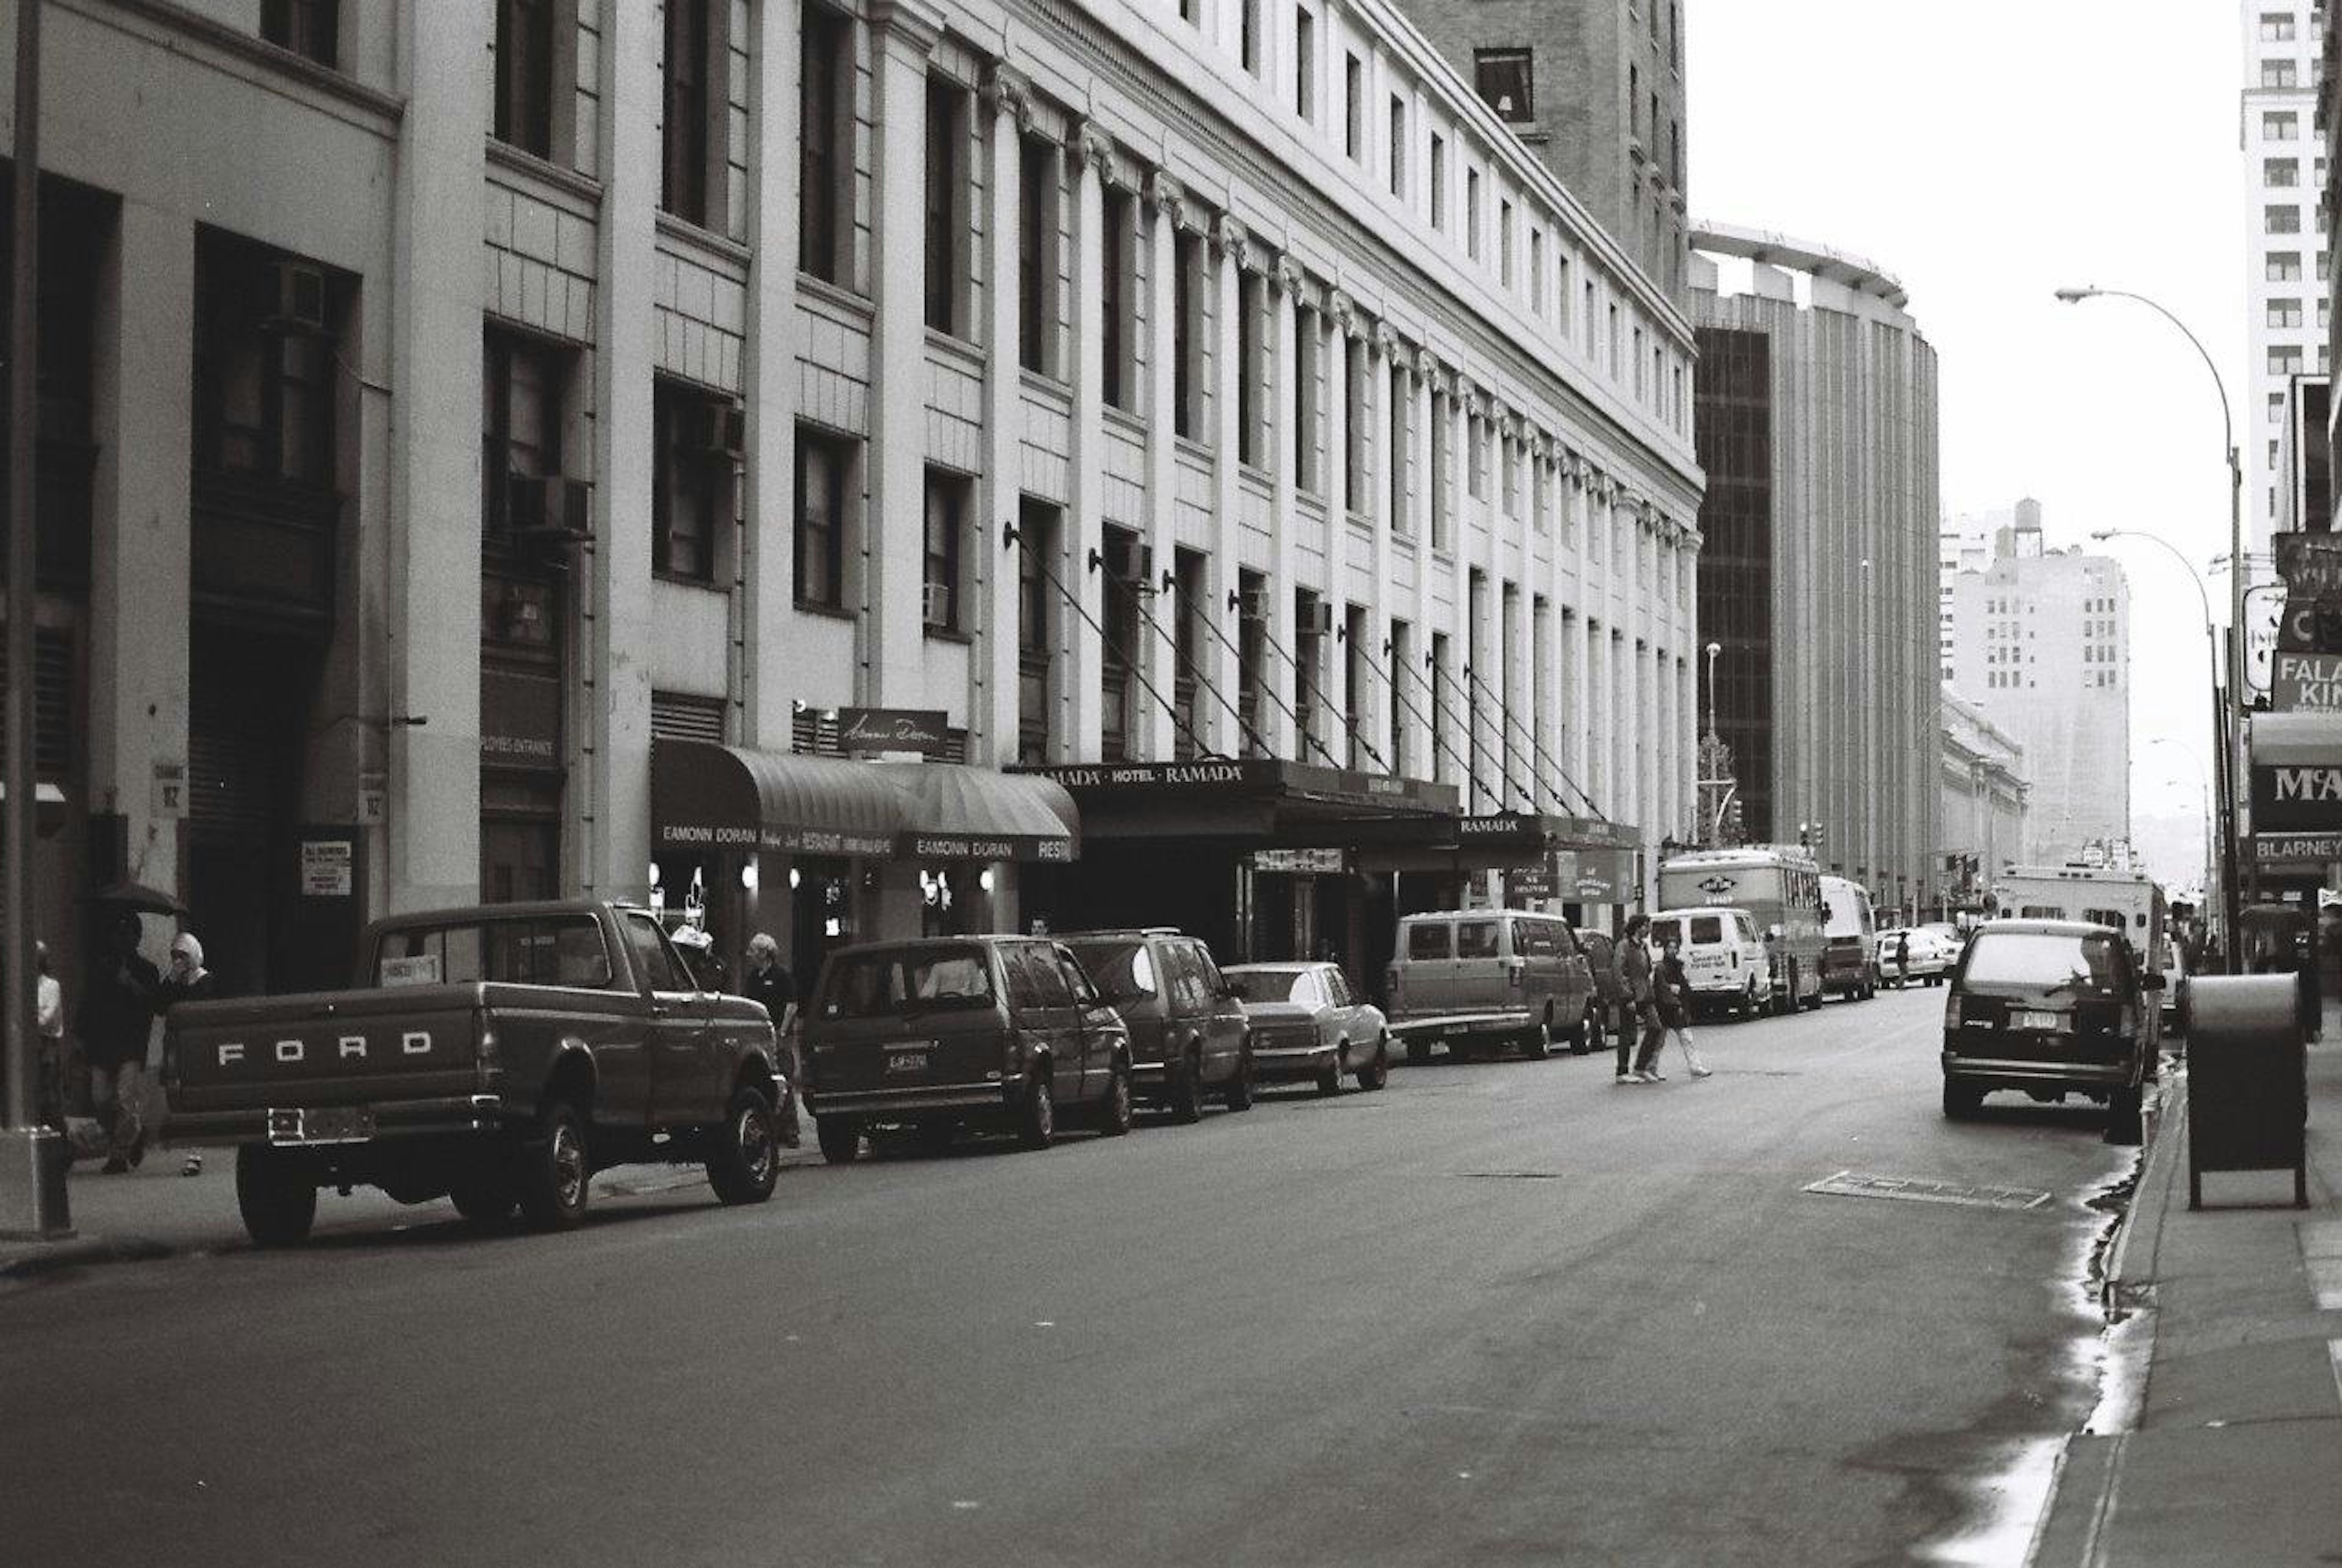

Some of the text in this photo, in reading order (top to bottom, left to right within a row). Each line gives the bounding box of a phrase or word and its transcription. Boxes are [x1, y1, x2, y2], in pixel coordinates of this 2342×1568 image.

[1111, 769, 1155, 782] HOTEL
[1166, 765, 1242, 782] RAMADA
[663, 825, 713, 841] EAMONN
[716, 828, 757, 843] DORAN
[1461, 820, 1518, 832] RAMADA
[917, 839, 1013, 856] EAMONN DORAN
[2257, 841, 2342, 857] BLARNEY
[218, 1031, 432, 1066] FORD
